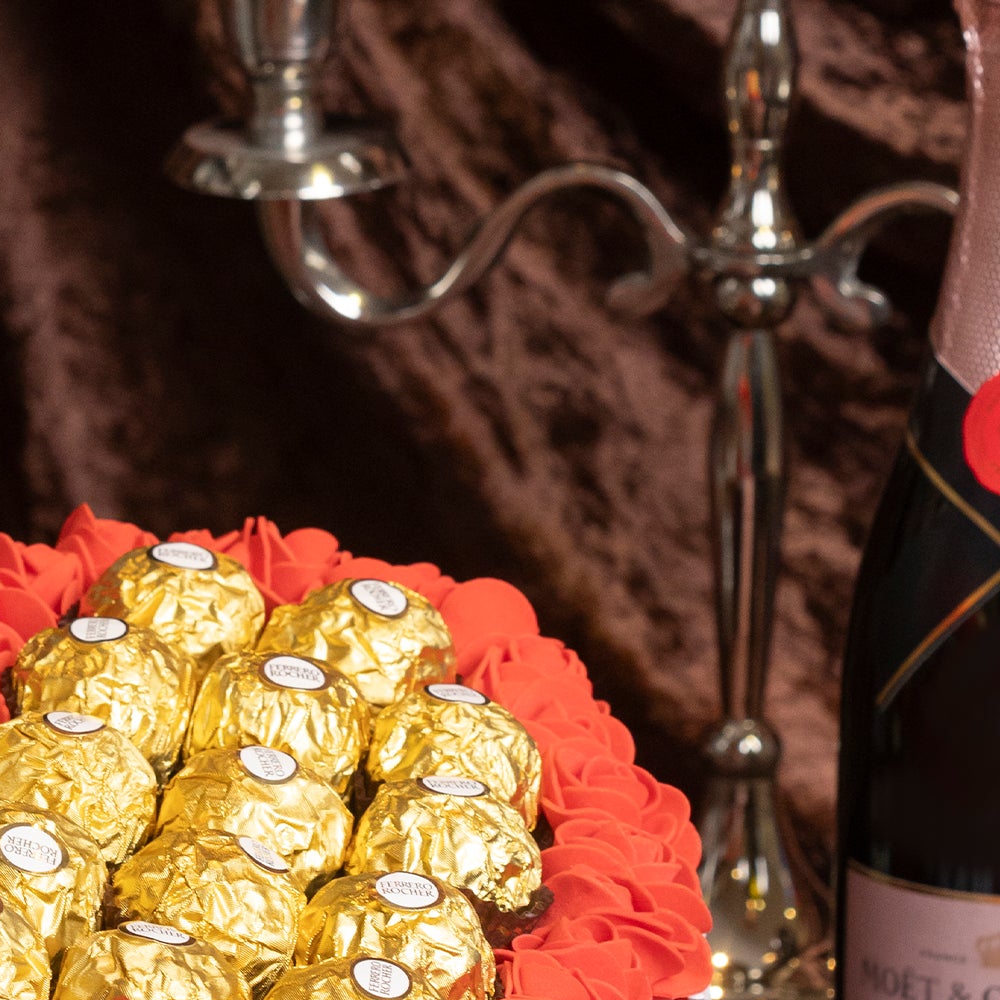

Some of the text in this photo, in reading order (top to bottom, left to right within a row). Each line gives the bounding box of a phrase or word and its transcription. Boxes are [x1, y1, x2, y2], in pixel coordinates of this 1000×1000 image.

[270, 664, 320, 676] FERRERO
[270, 670, 320, 681] ROCHER
[8, 835, 57, 856] ROCHER
[380, 881, 433, 890] FERRERO
[382, 888, 434, 897] ROCHER
[369, 961, 381, 992] FERRERO
[380, 964, 392, 995] ROCHER
